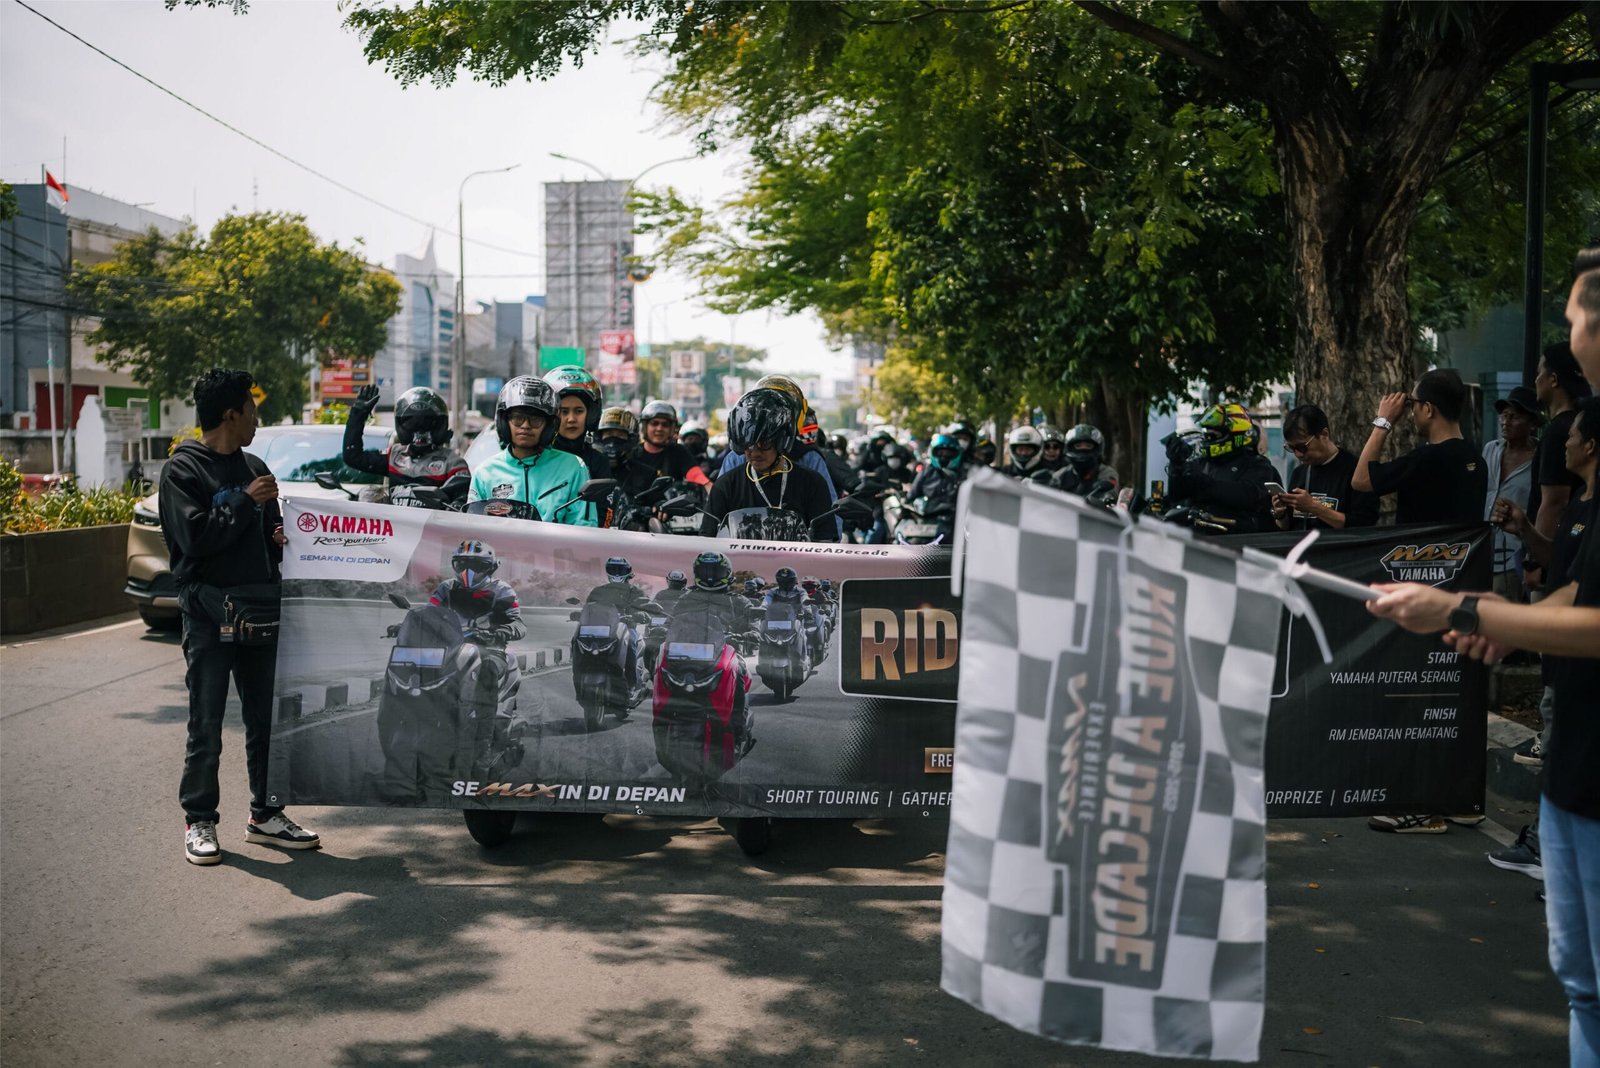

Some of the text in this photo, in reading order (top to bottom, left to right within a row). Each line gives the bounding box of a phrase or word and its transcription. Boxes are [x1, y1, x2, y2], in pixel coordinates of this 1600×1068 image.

[319, 514, 394, 537] YAMAHA
[312, 536, 343, 546] Revs
[343, 537, 361, 547] your
[299, 554, 344, 562] SEMAKIN
[357, 557, 391, 565] DEPAN
[1399, 568, 1446, 581] YAMAHA
[1427, 651, 1459, 664] START
[1330, 670, 1460, 684] YAMAHA PUTERA SERANG
[1423, 708, 1456, 720] FINISH
[1328, 726, 1458, 741] RM JEMBATAN PEMATANG
[588, 785, 610, 801] DI
[616, 786, 686, 804] DEPAN
[766, 789, 813, 804] SHORT
[817, 790, 880, 805] TOURING
[1343, 788, 1387, 803] GAMES
